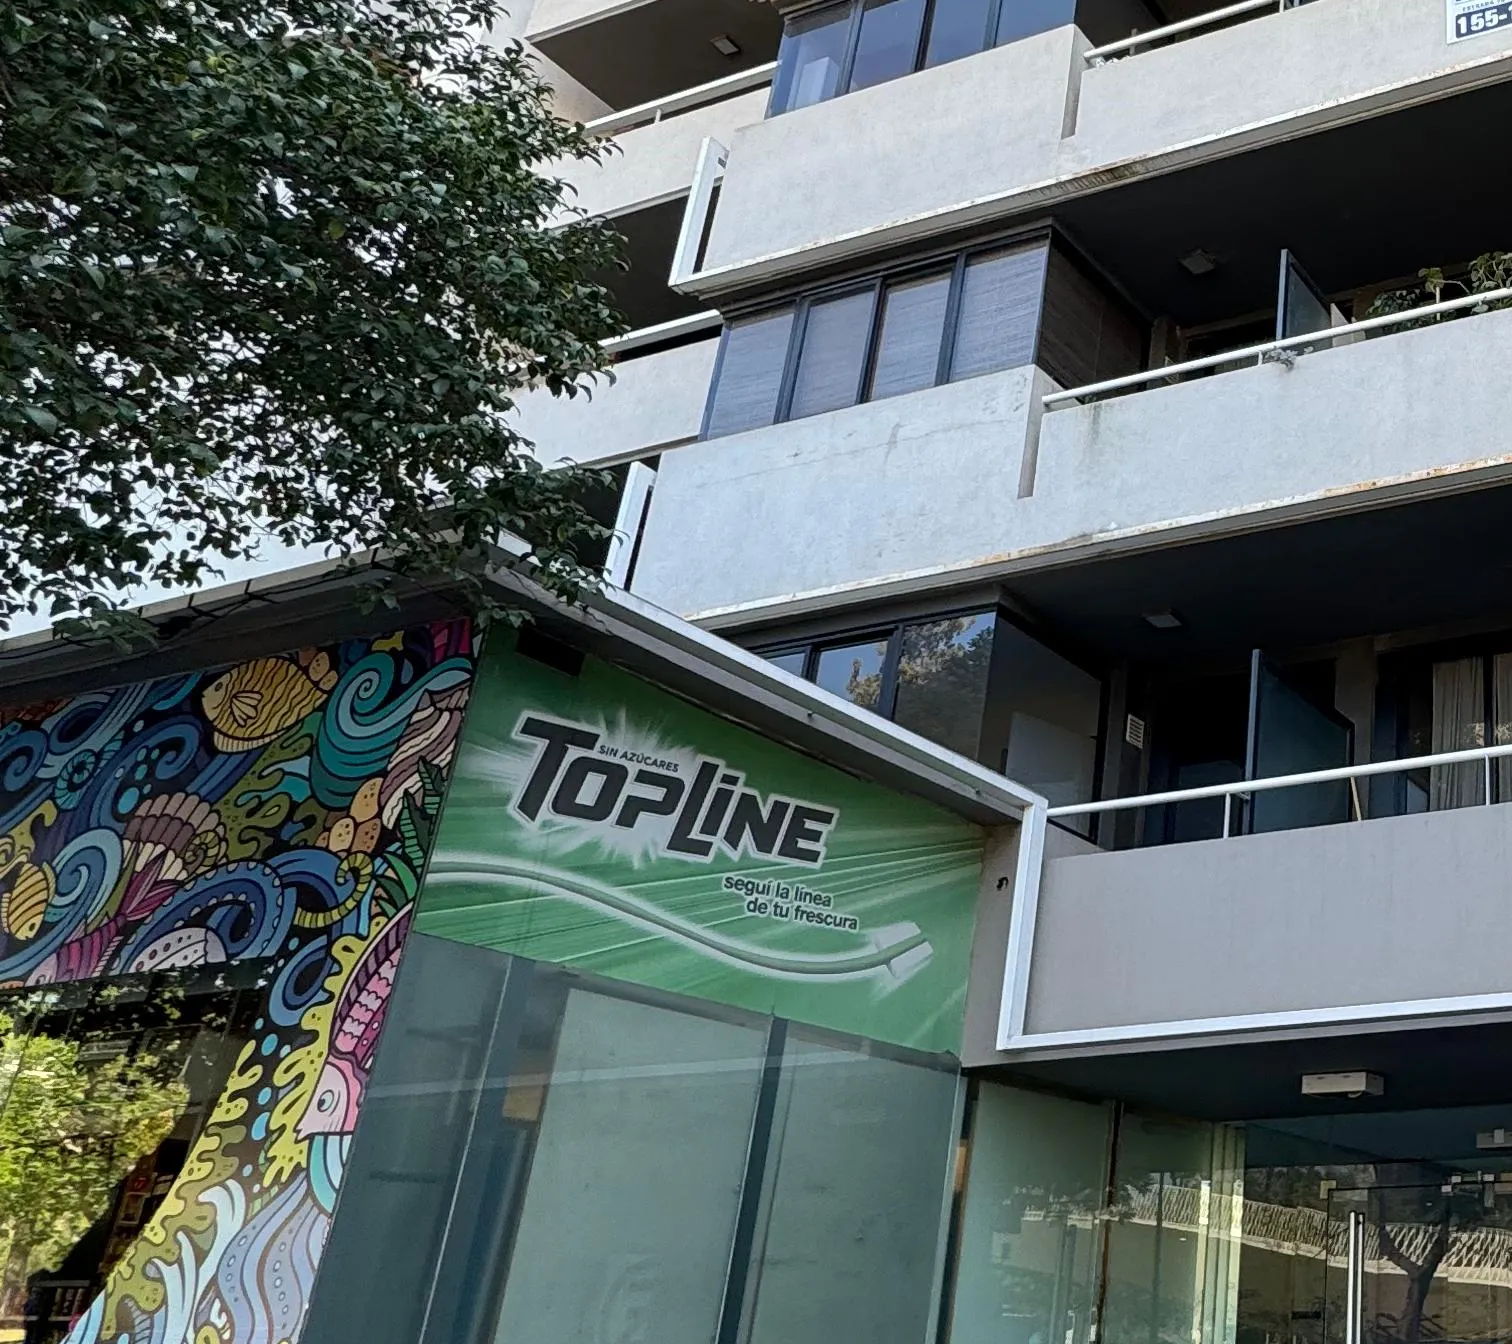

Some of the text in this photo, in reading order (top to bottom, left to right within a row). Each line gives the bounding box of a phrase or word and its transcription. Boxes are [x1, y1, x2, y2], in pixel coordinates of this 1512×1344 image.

[599, 744, 679, 773] SIN AZÚCARES
[723, 875, 832, 908] seguí la línea
[746, 898, 859, 931] de tu frescura
